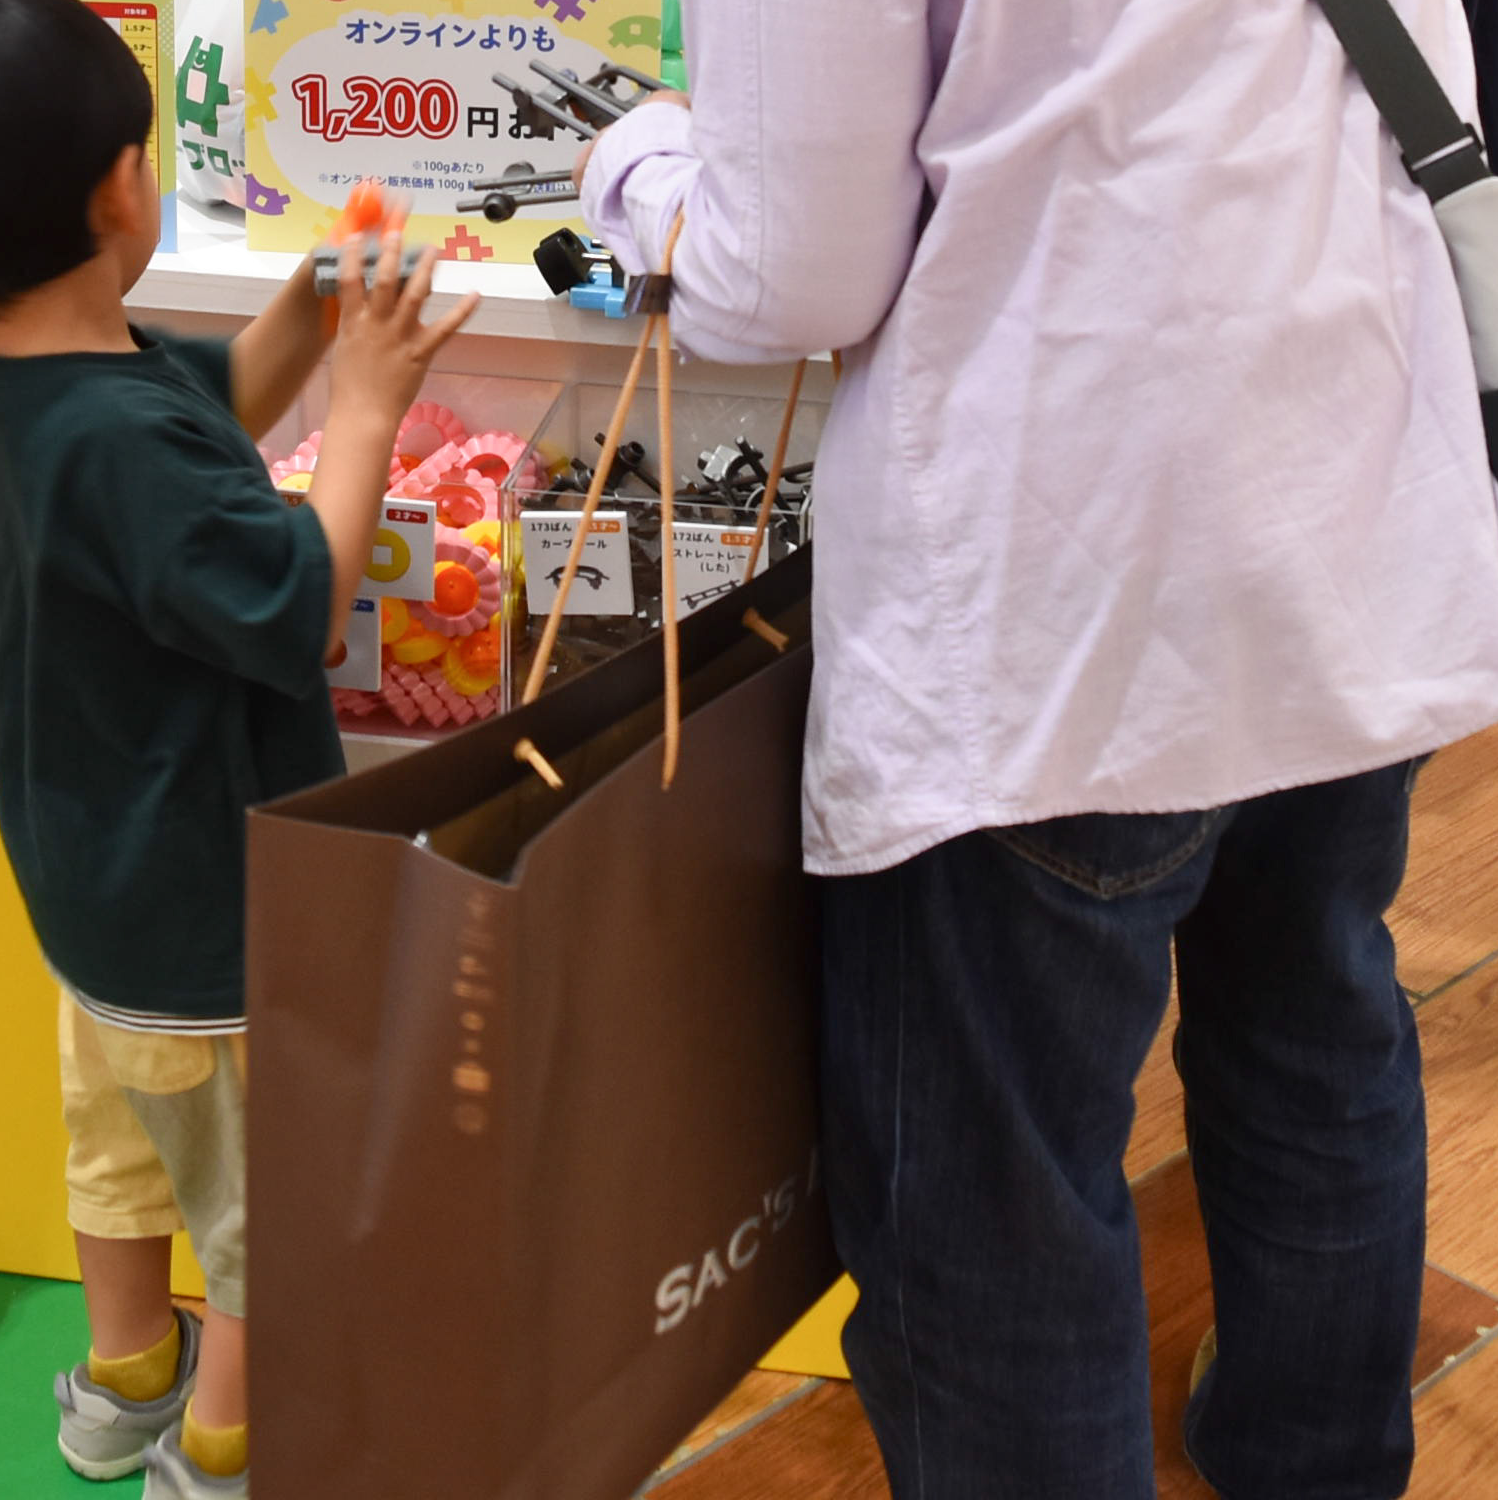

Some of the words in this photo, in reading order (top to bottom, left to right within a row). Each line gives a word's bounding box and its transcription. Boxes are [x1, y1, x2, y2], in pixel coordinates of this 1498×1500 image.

[345, 17, 556, 52] オンラインよりも
[438, 178, 465, 193] 100g
[530, 522, 572, 532] 173ばん
[541, 539, 608, 549] カーブール
[700, 562, 731, 574] (した)
